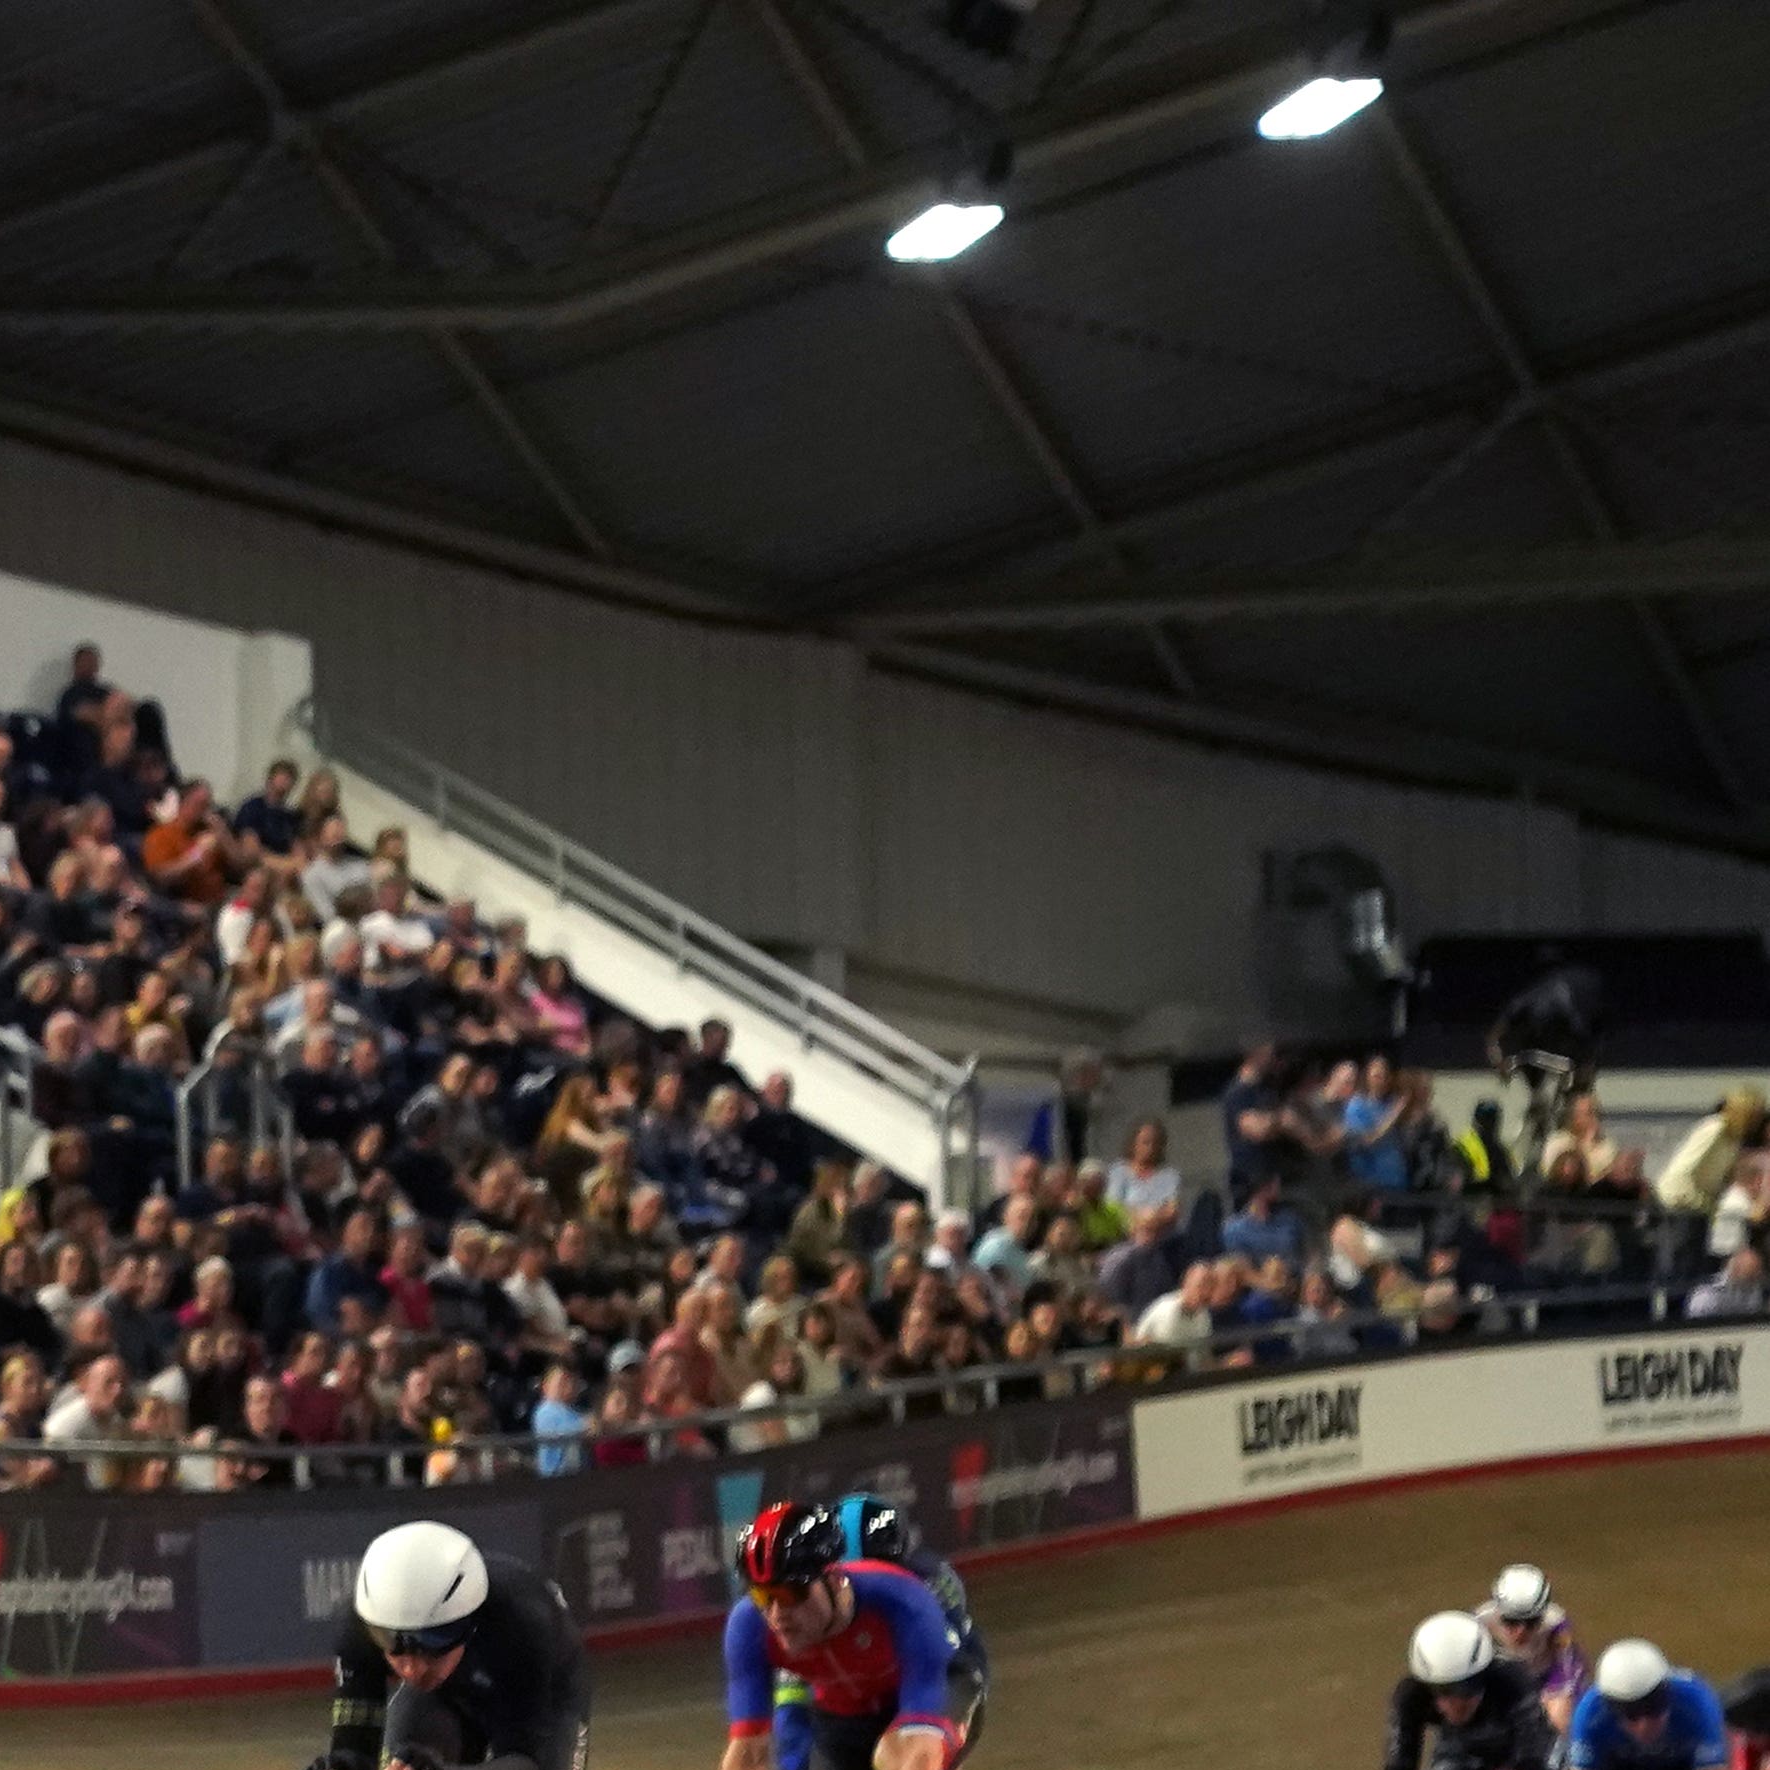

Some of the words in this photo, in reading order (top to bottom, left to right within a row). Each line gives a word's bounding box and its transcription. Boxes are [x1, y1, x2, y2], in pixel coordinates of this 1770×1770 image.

[1599, 1350, 1686, 1406] LEIGH
[1688, 1343, 1743, 1397] DAY
[1238, 1391, 1314, 1456] LEIGH
[1315, 1382, 1363, 1440] DAY
